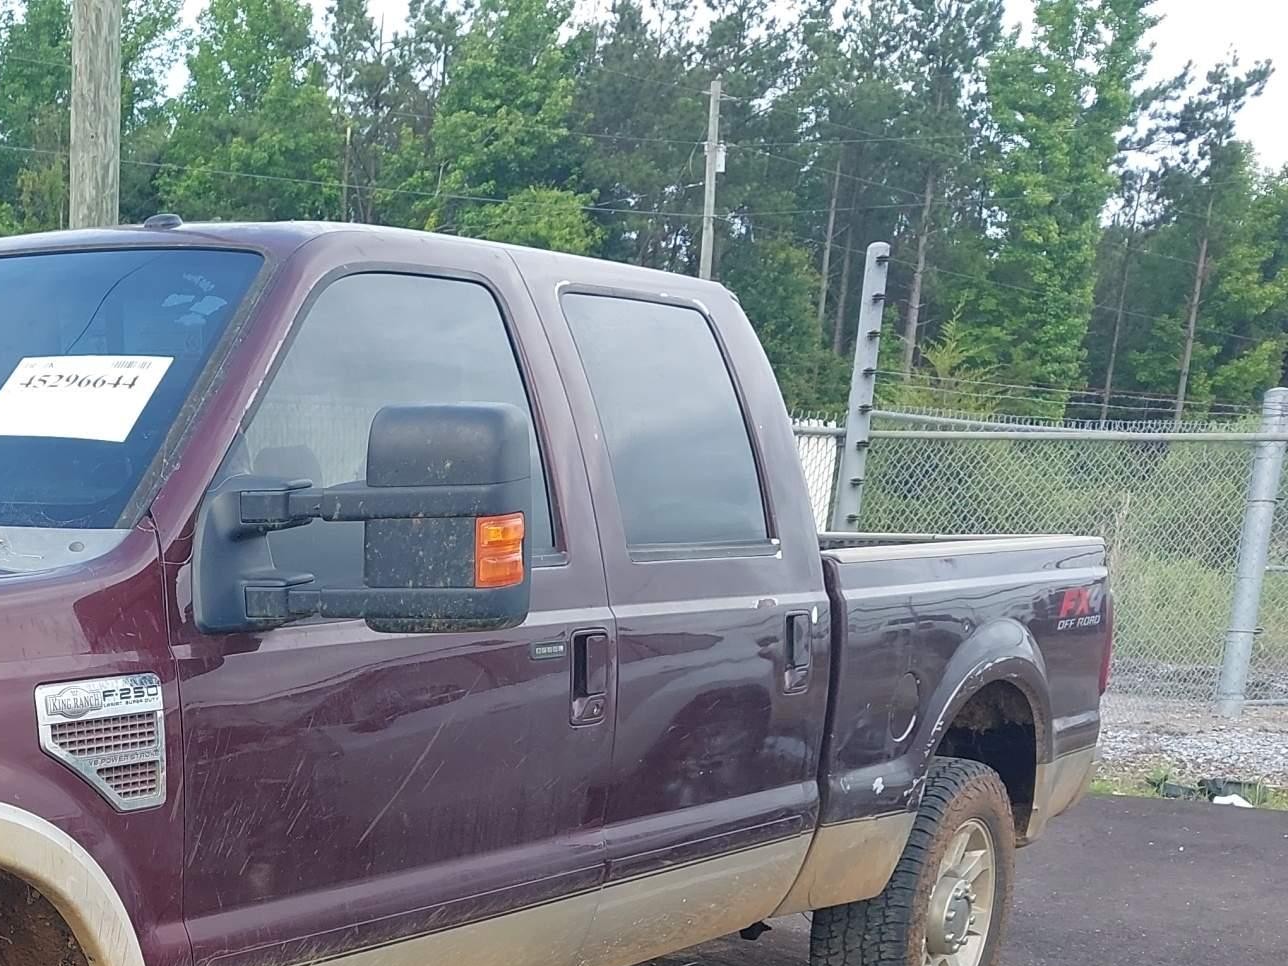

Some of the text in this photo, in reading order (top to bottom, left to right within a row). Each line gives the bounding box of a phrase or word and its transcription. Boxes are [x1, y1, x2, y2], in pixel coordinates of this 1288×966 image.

[19, 373, 141, 389] 45296644
[1059, 584, 1104, 617] FX4
[1057, 615, 1101, 631] OFF ROAD
[50, 692, 100, 712] KING RANCH
